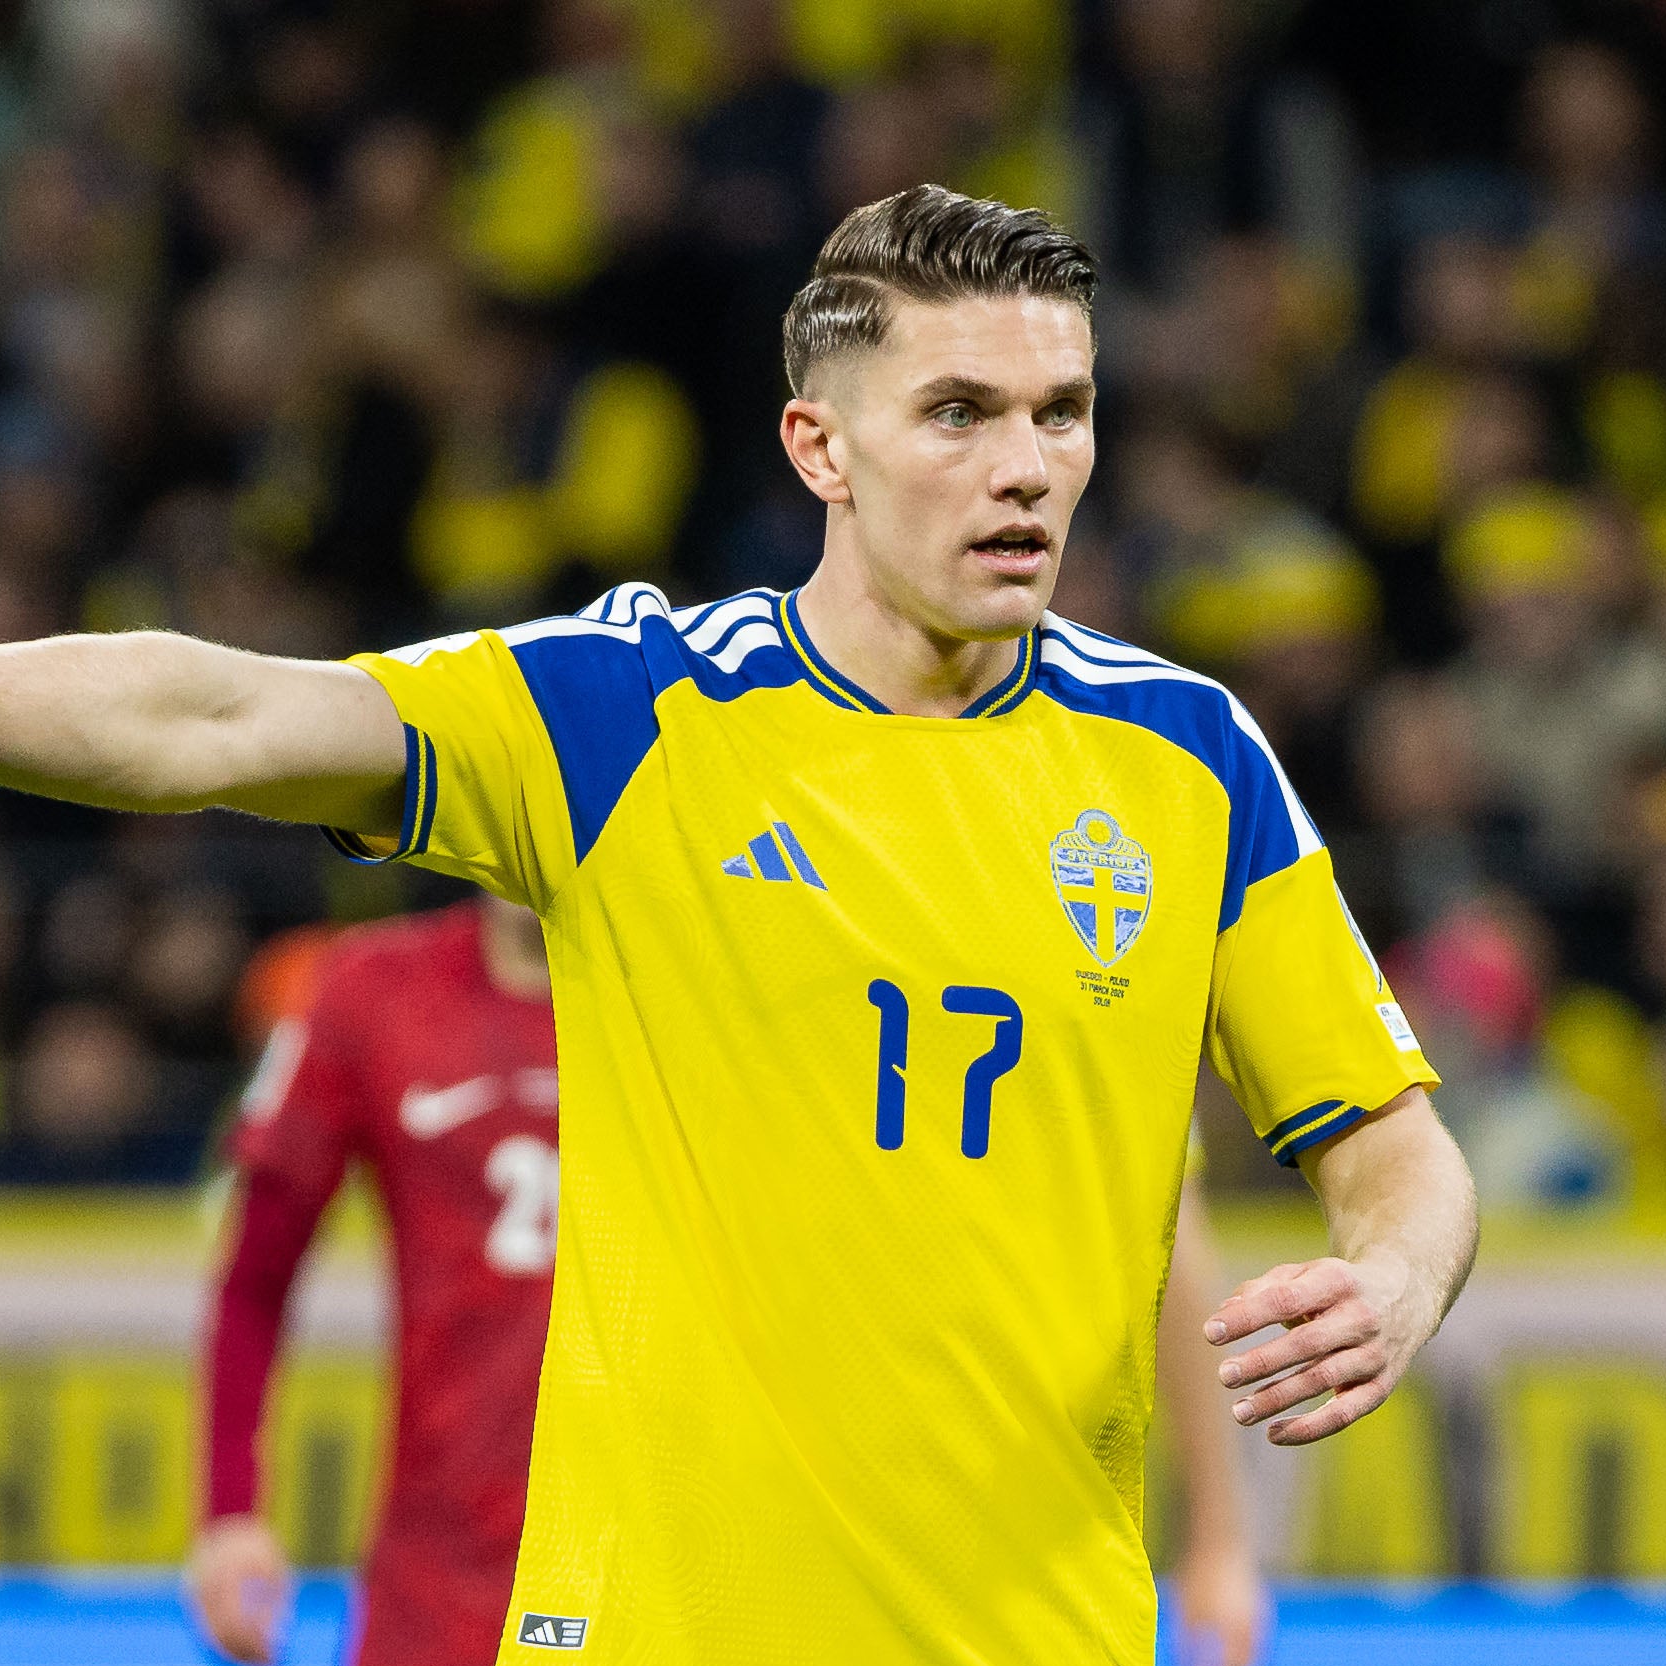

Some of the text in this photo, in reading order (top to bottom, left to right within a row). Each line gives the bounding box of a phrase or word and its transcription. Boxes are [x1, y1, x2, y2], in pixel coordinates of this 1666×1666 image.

[1067, 850, 1134, 870] SVERIGE
[867, 978, 1024, 1160] 17
[484, 1134, 559, 1277] 2
